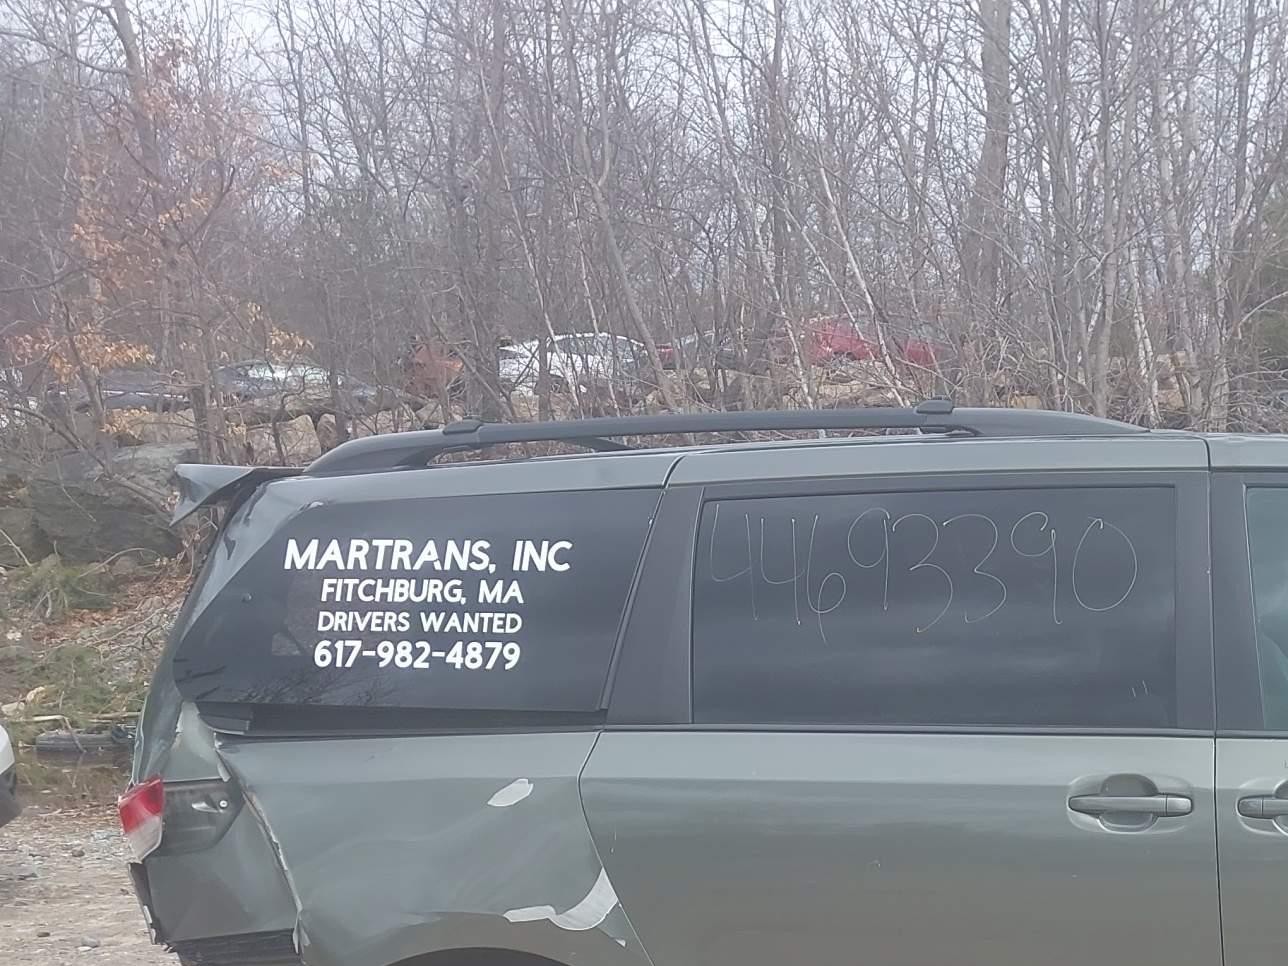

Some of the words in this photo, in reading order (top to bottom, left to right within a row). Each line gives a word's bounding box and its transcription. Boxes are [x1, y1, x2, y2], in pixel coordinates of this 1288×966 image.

[284, 538, 496, 575] MARTRANS,
[512, 540, 573, 572] INC
[711, 503, 1138, 644] 44693390
[320, 578, 466, 605] FITCHBURG,
[478, 580, 524, 604] MA
[317, 611, 410, 632] DRIVERS
[420, 612, 523, 634] WANTED
[314, 640, 521, 671] 617-982-4879
